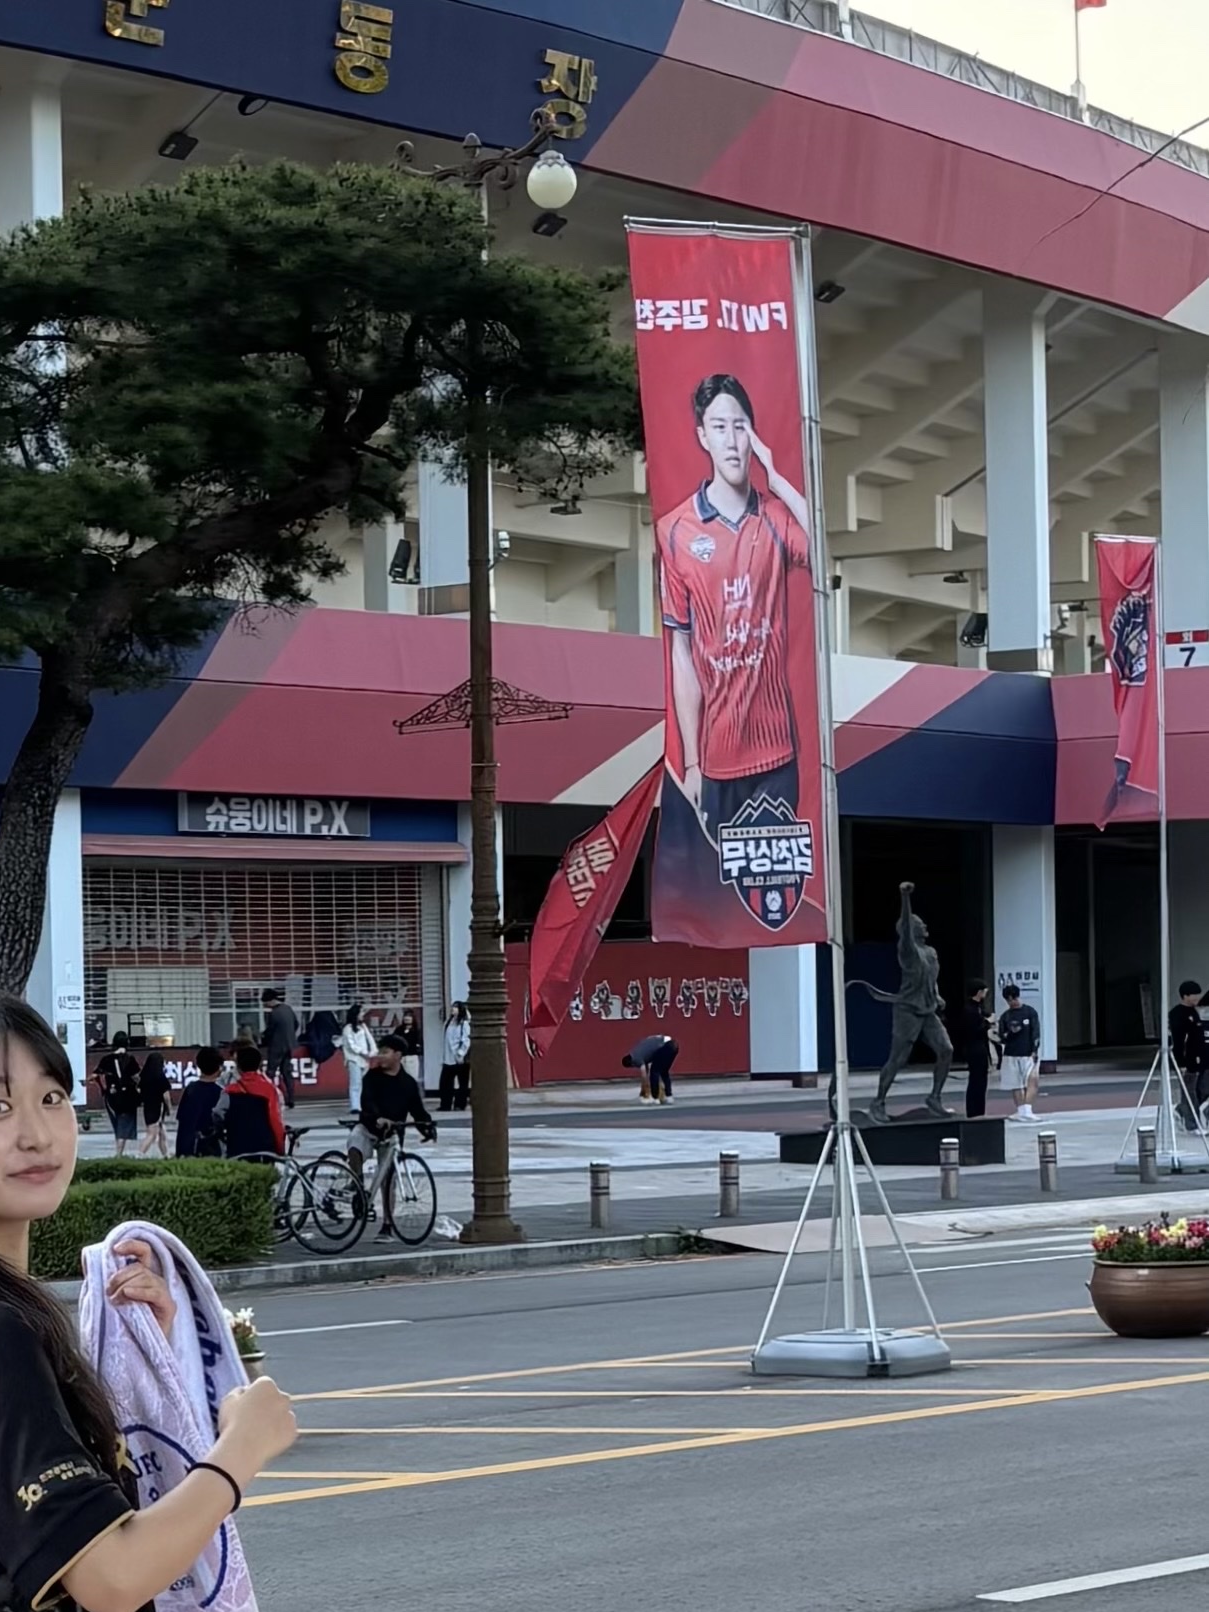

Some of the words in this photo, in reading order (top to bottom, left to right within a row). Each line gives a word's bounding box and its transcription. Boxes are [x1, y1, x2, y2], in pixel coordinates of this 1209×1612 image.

[1179, 646, 1197, 667] 7
[205, 797, 297, 834] 슈웅이네
[304, 799, 350, 835] P.X
